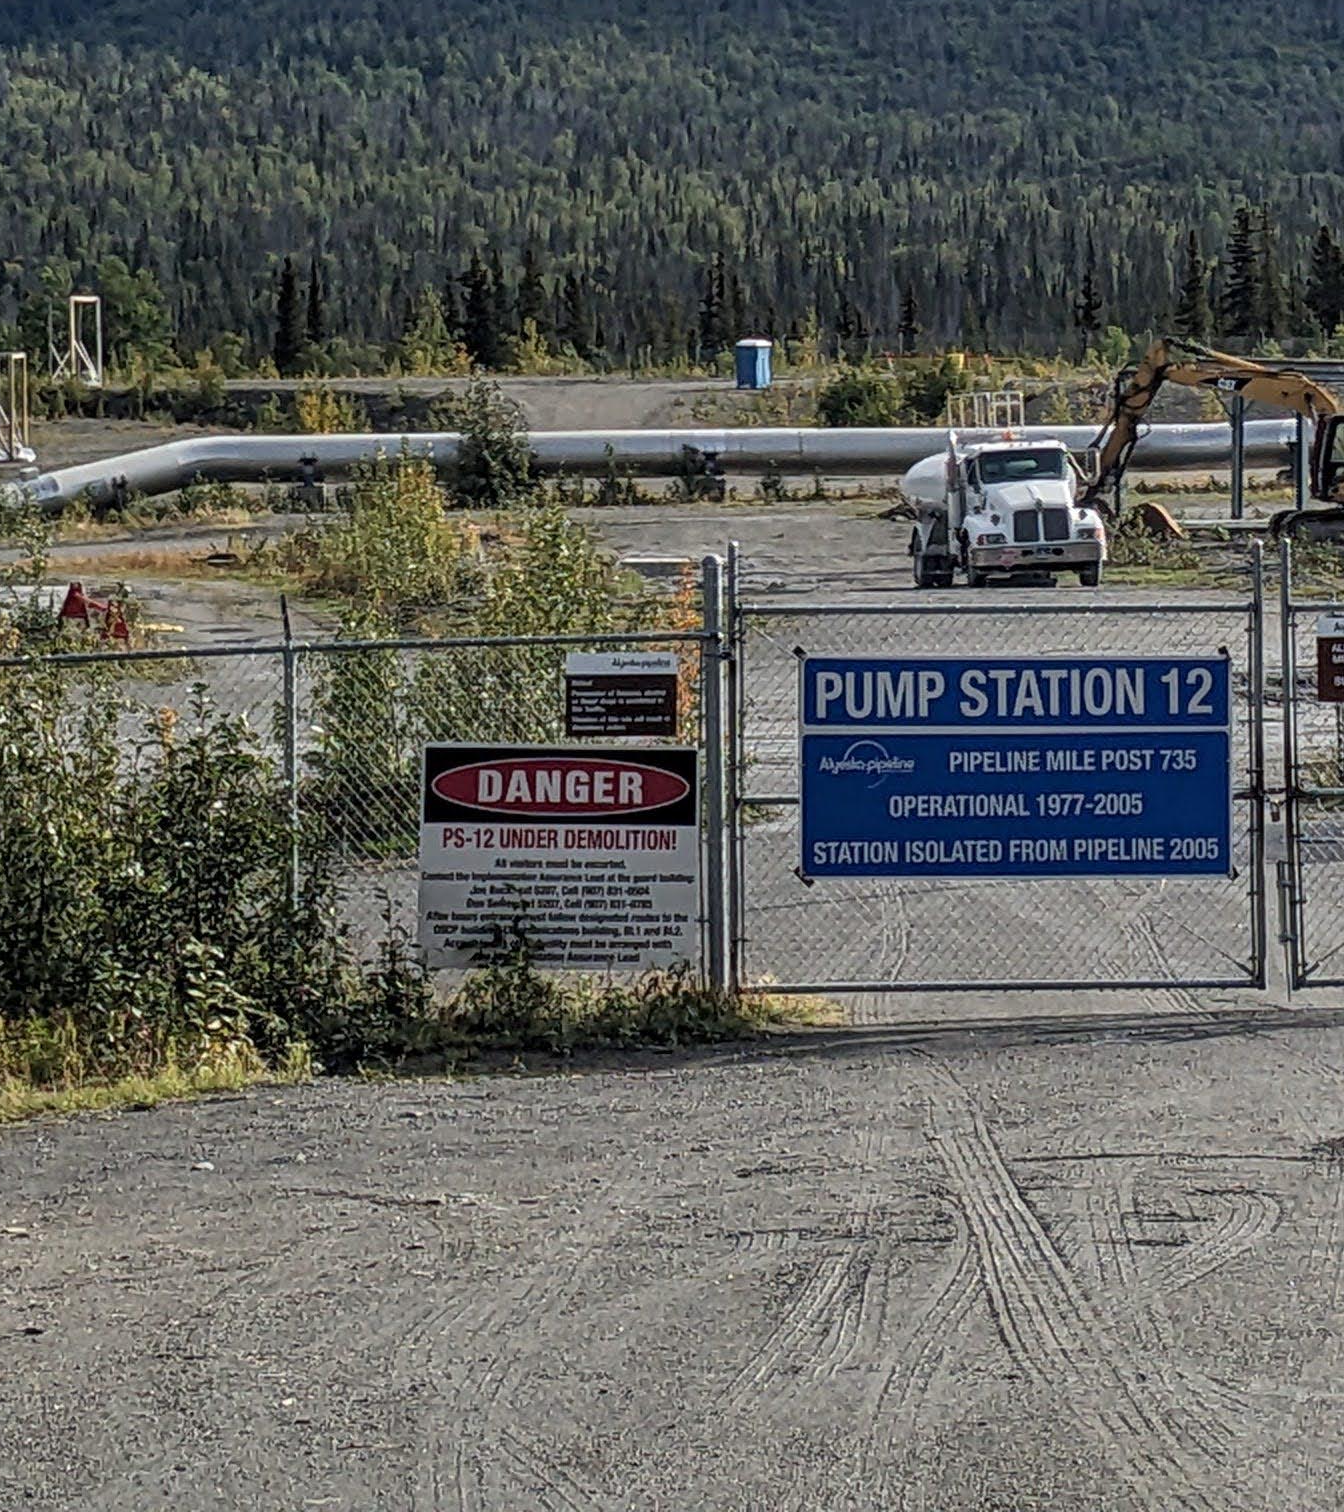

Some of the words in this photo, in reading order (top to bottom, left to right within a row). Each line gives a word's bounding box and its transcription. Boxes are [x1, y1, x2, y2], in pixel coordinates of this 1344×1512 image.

[816, 670, 945, 719] PUMP
[960, 668, 1145, 716] STATION
[1160, 668, 1213, 714] 12
[949, 750, 1040, 773] PIPELINE
[1046, 750, 1096, 771] MILE
[1101, 749, 1154, 771] POST
[1160, 749, 1196, 770] 735
[478, 769, 643, 804] DANGER
[889, 794, 1030, 818] OPERATIONAL
[1036, 793, 1143, 816] 1977-2005
[443, 828, 493, 849] PS-12
[500, 828, 558, 849] UNDER
[564, 829, 677, 850] DEMOLITION!
[813, 841, 898, 864] STATION
[905, 840, 1002, 863] ISOLATED
[1009, 840, 1068, 862] FROM
[1073, 838, 1165, 861] PIPELINE
[1169, 837, 1218, 860] 2005
